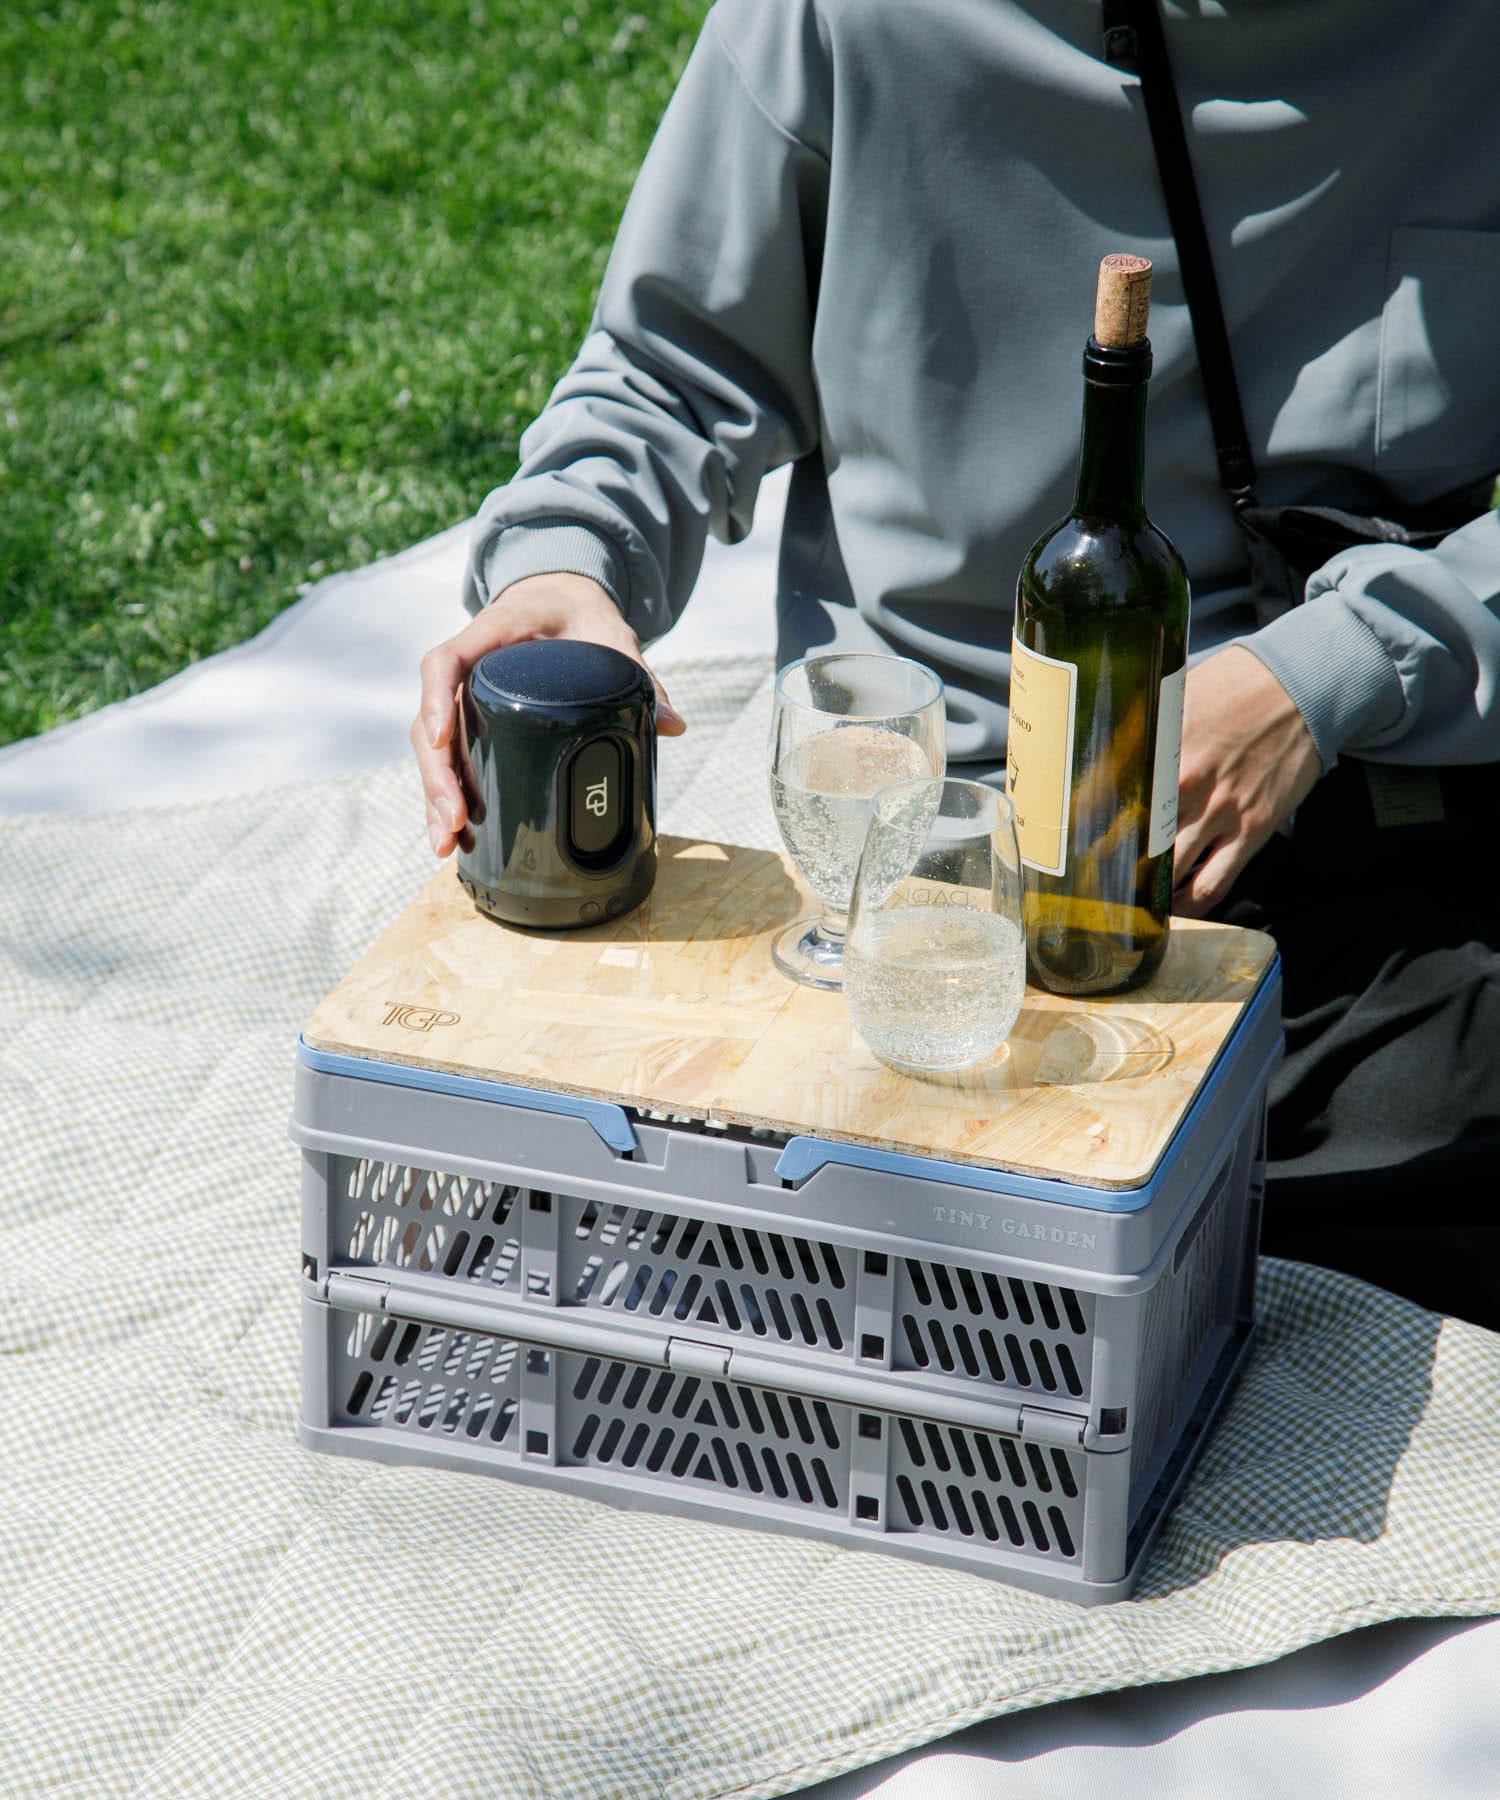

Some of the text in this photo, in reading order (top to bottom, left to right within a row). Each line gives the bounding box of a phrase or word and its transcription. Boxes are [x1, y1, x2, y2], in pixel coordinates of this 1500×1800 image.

[586, 776, 607, 816] TGP
[382, 1001, 461, 1032] TGP
[933, 1206, 1097, 1250] TINY GARDEN
